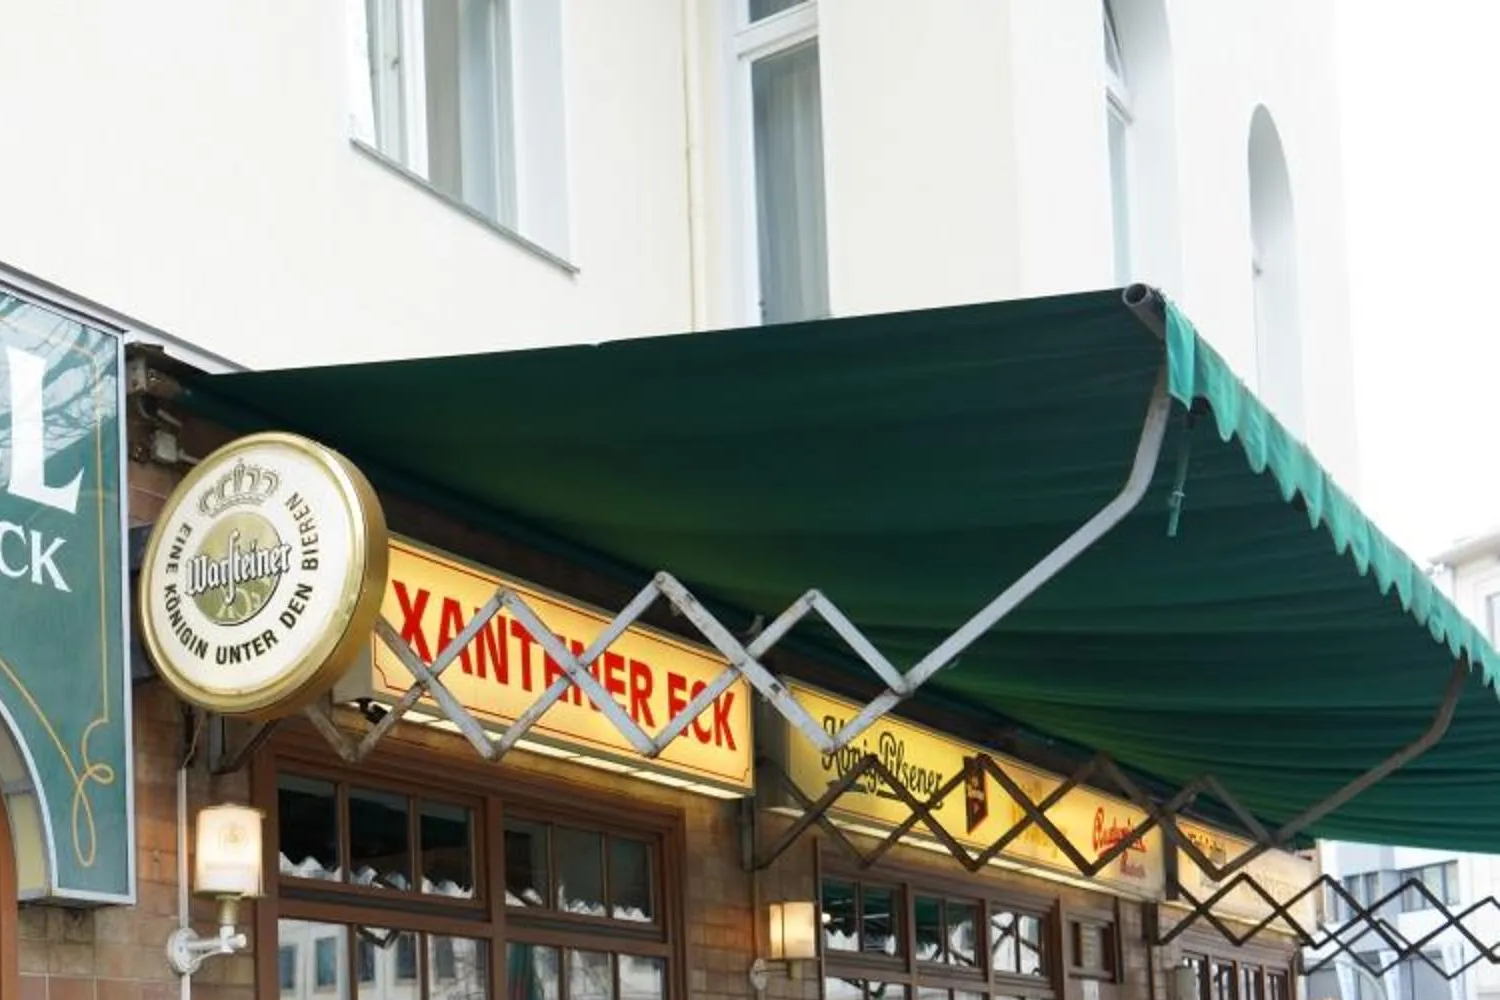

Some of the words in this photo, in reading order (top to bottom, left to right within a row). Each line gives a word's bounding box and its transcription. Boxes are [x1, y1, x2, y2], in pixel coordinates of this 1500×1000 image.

[166, 522, 193, 574] EINE
[284, 492, 319, 571] BIEREN
[185, 530, 292, 606] Warsteiner
[164, 583, 209, 660] KÖNIGIN
[278, 583, 313, 630] DEN
[215, 628, 279, 665] UNTER
